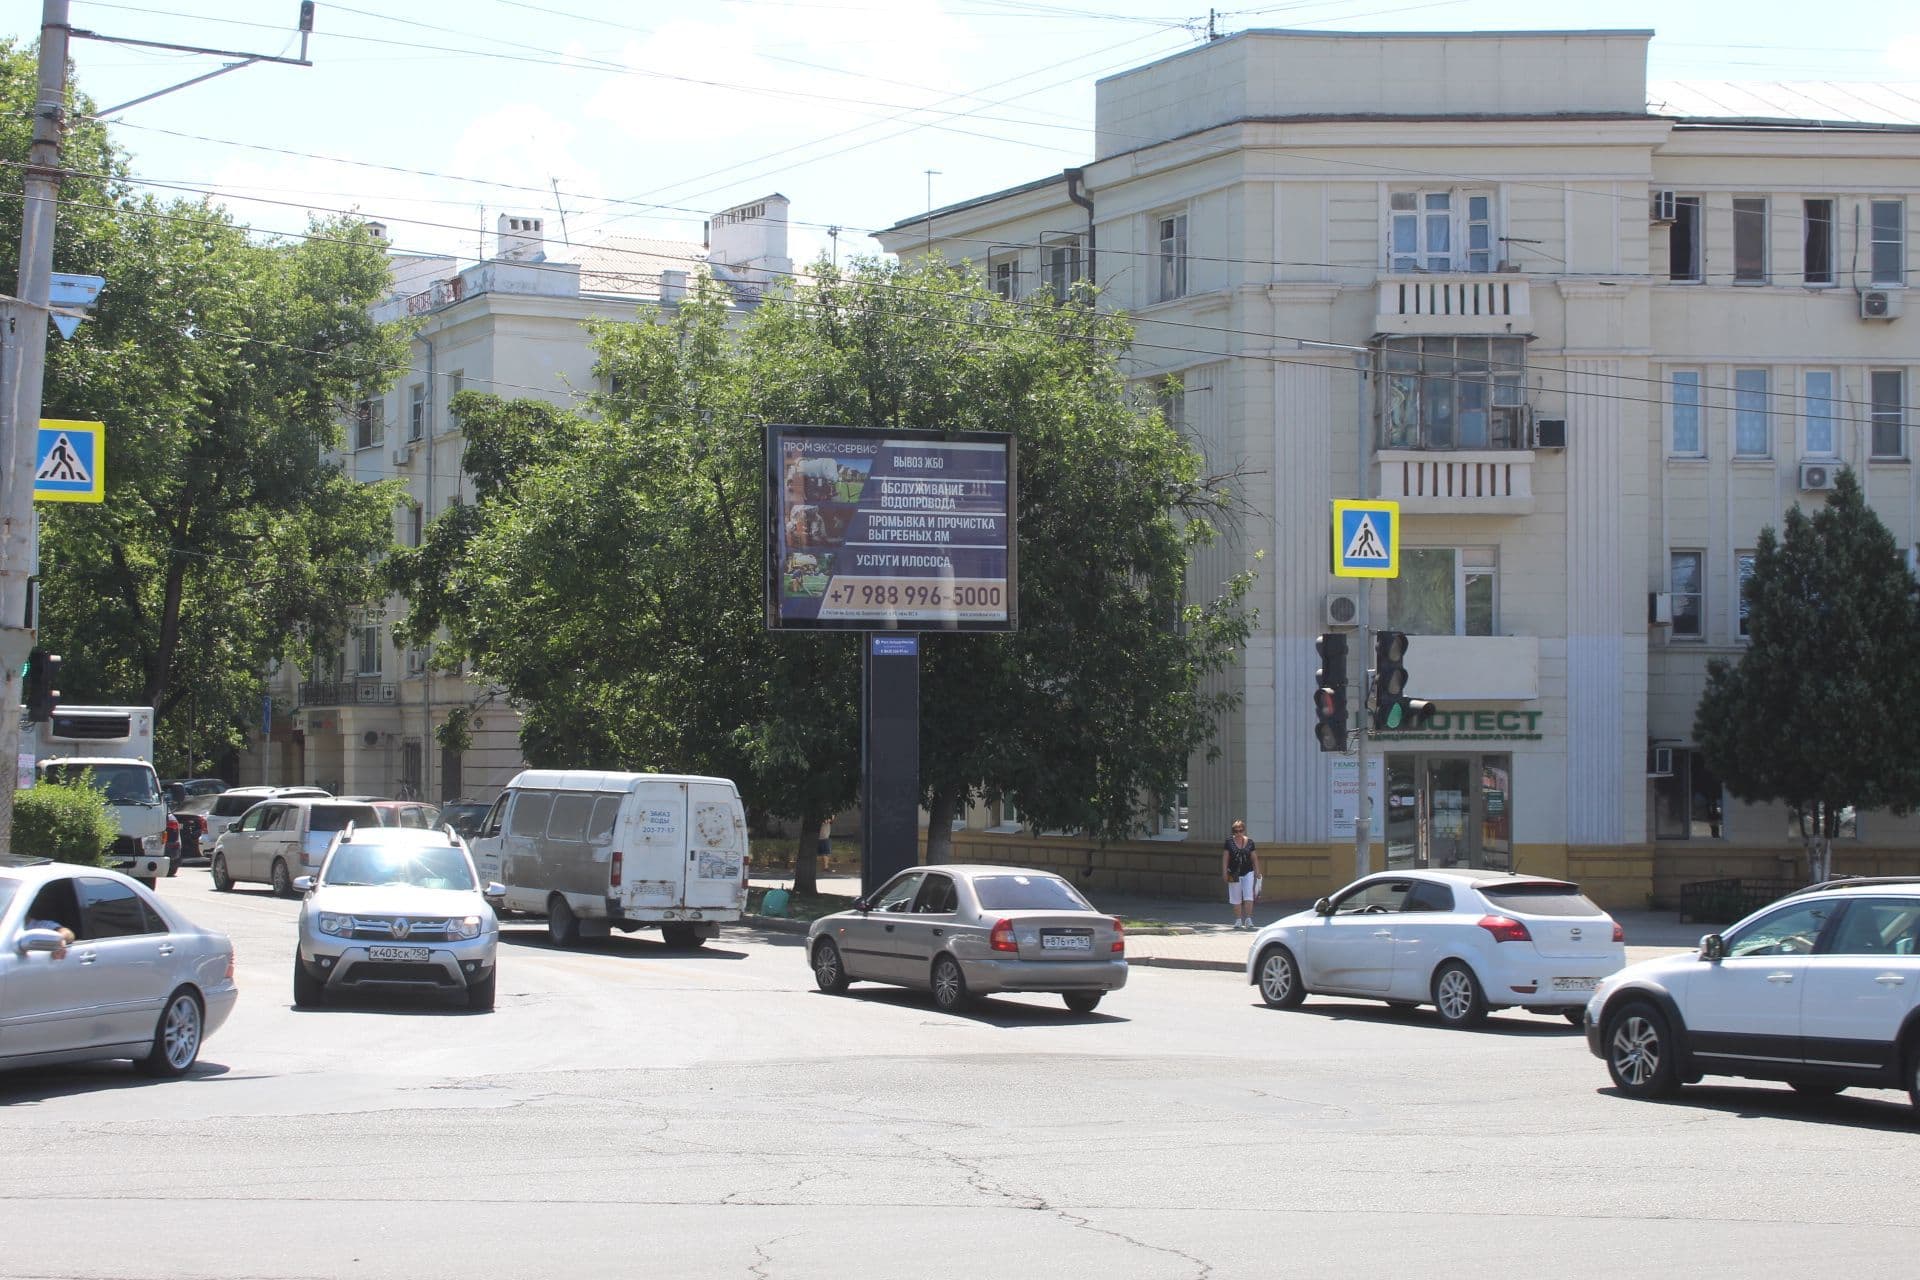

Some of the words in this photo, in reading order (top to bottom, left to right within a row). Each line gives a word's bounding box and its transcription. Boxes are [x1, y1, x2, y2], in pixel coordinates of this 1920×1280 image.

[894, 456, 923, 469] ВЫВОЗ
[925, 457, 944, 469] ЖБО
[881, 482, 965, 496] ОБСЛУЖИВАНИЕ
[881, 496, 957, 510] ВОДОПРОВОДА
[869, 515, 925, 529] ПРОМЫВКА
[928, 516, 935, 528] И
[938, 517, 996, 530] ПРОЧИСТКА
[868, 529, 932, 542] ВЫГРЕБНЫХ
[934, 530, 950, 542] ЯМ
[857, 554, 899, 568] УСЛУГИ
[902, 555, 951, 568] ИЛОСОСА
[830, 584, 856, 604] +7
[862, 585, 899, 605] 988
